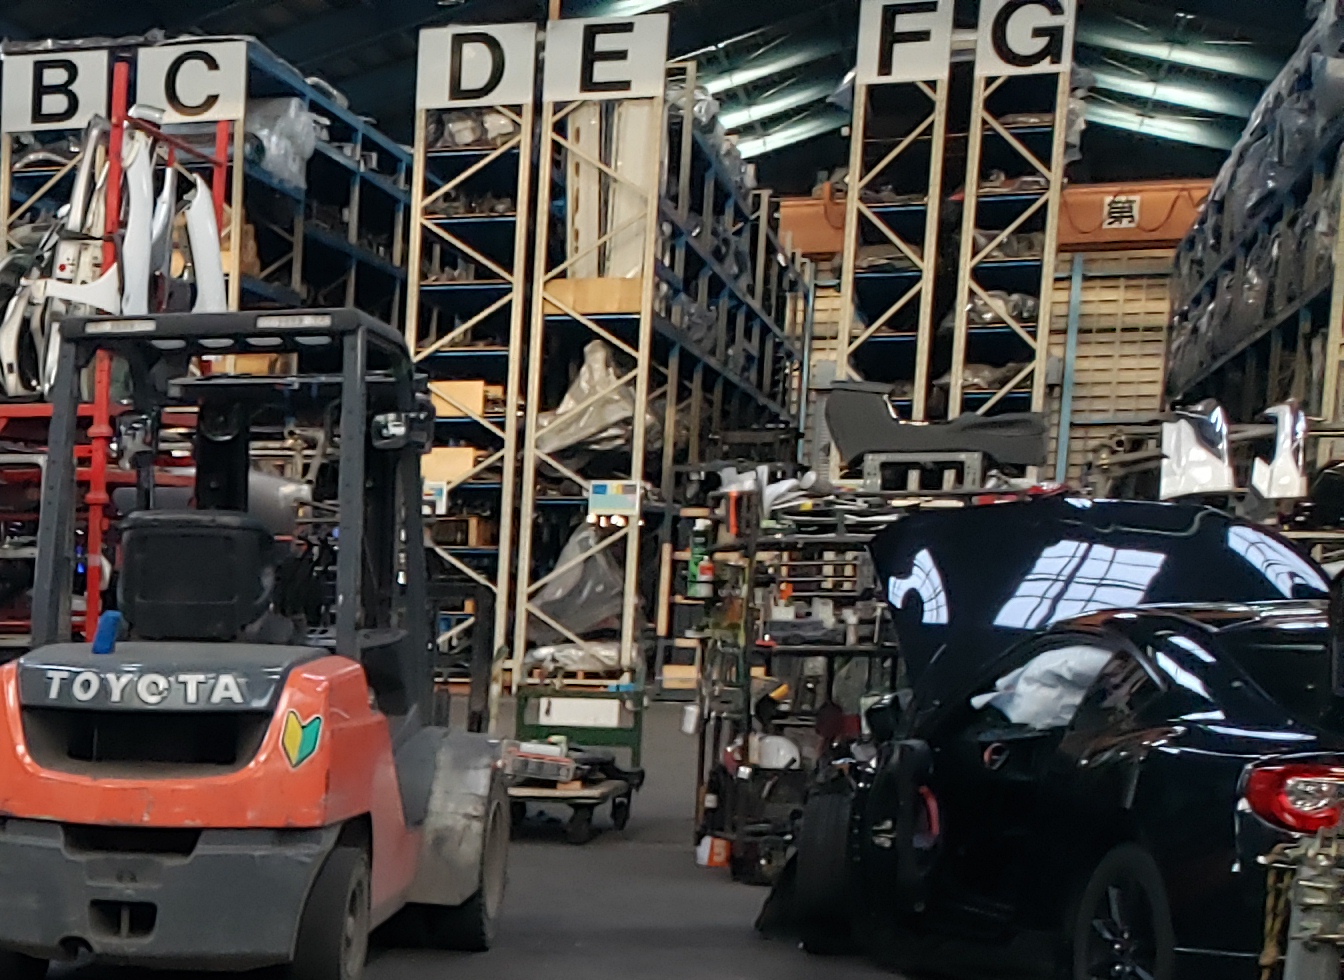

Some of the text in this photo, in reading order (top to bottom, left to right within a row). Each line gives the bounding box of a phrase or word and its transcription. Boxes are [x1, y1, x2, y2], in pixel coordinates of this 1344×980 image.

[449, 31, 506, 101] D
[580, 21, 635, 93] E
[877, 0, 939, 77] F
[991, 0, 1065, 68] G
[30, 58, 80, 125] B
[164, 49, 220, 117] C
[1107, 199, 1136, 225] 第
[45, 670, 245, 704] TOYOTA
